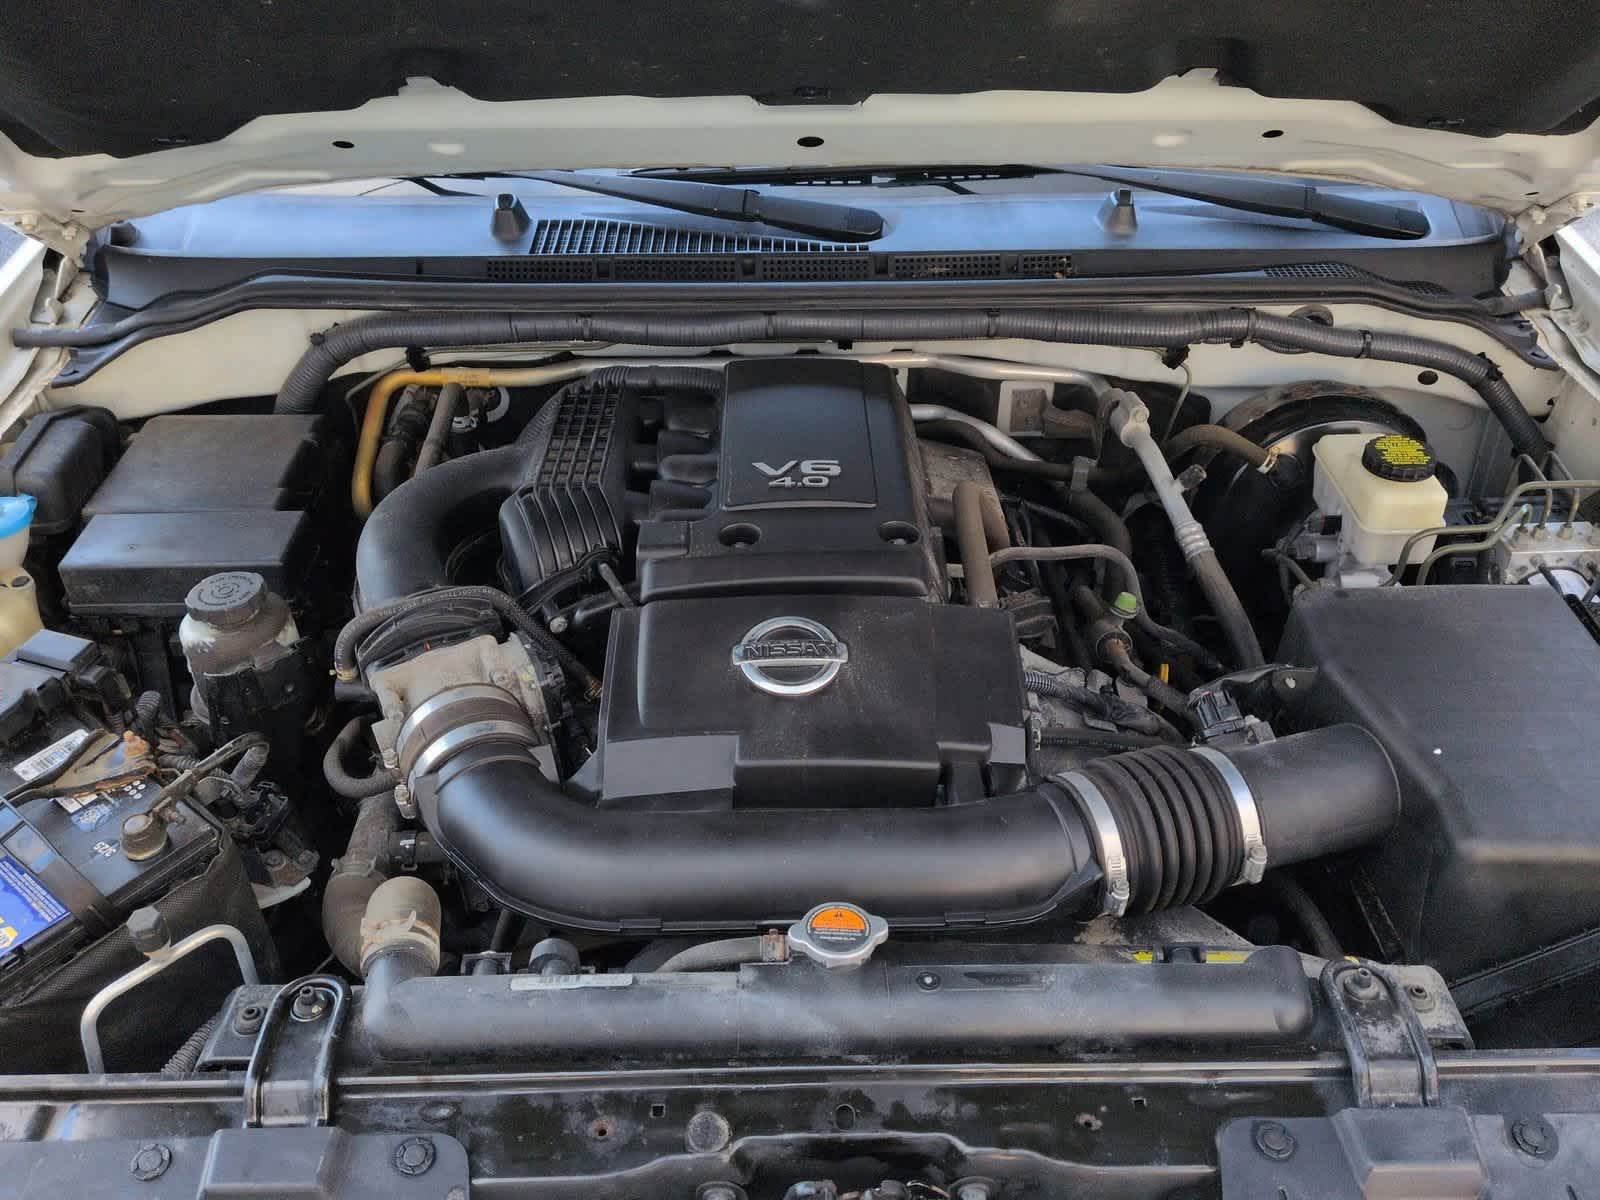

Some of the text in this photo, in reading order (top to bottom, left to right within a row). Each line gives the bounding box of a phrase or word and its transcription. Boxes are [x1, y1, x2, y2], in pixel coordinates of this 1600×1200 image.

[752, 459, 842, 476] V6
[768, 476, 829, 488] 4.0
[744, 641, 836, 657] NISSAN
